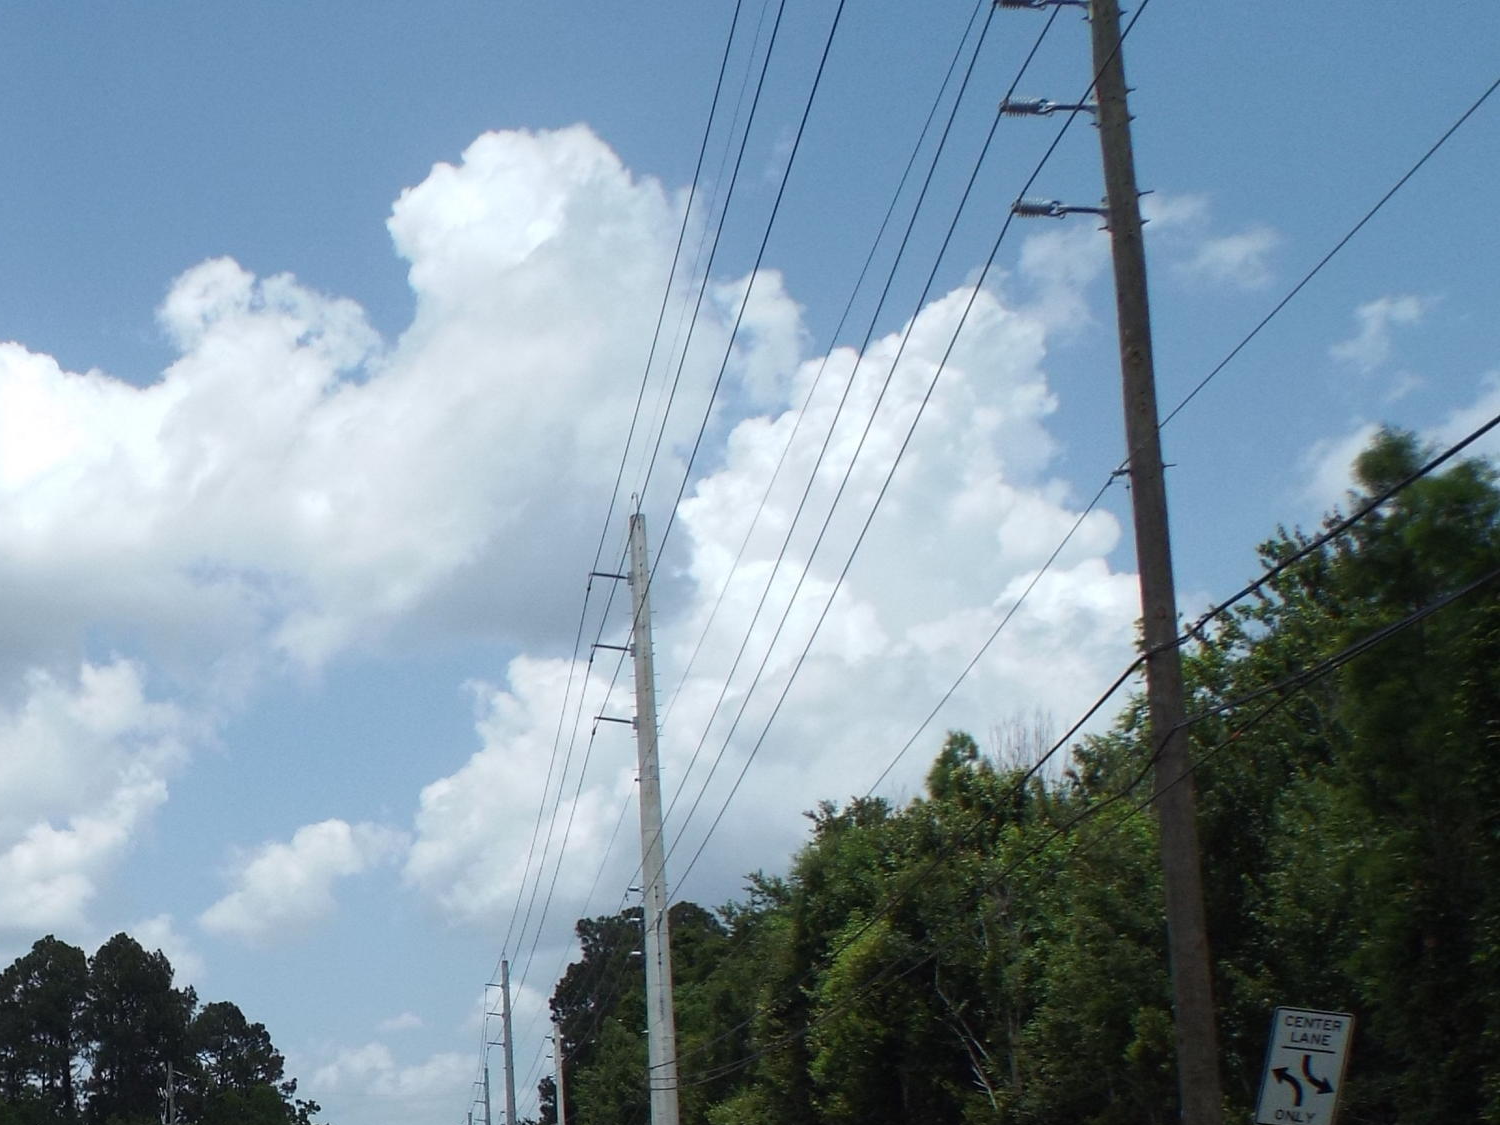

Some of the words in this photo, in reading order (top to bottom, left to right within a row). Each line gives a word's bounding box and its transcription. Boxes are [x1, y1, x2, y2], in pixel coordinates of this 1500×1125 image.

[1284, 1015, 1342, 1031] CENTER
[1290, 1031, 1332, 1046] LANE
[1274, 1108, 1316, 1124] ONLY
